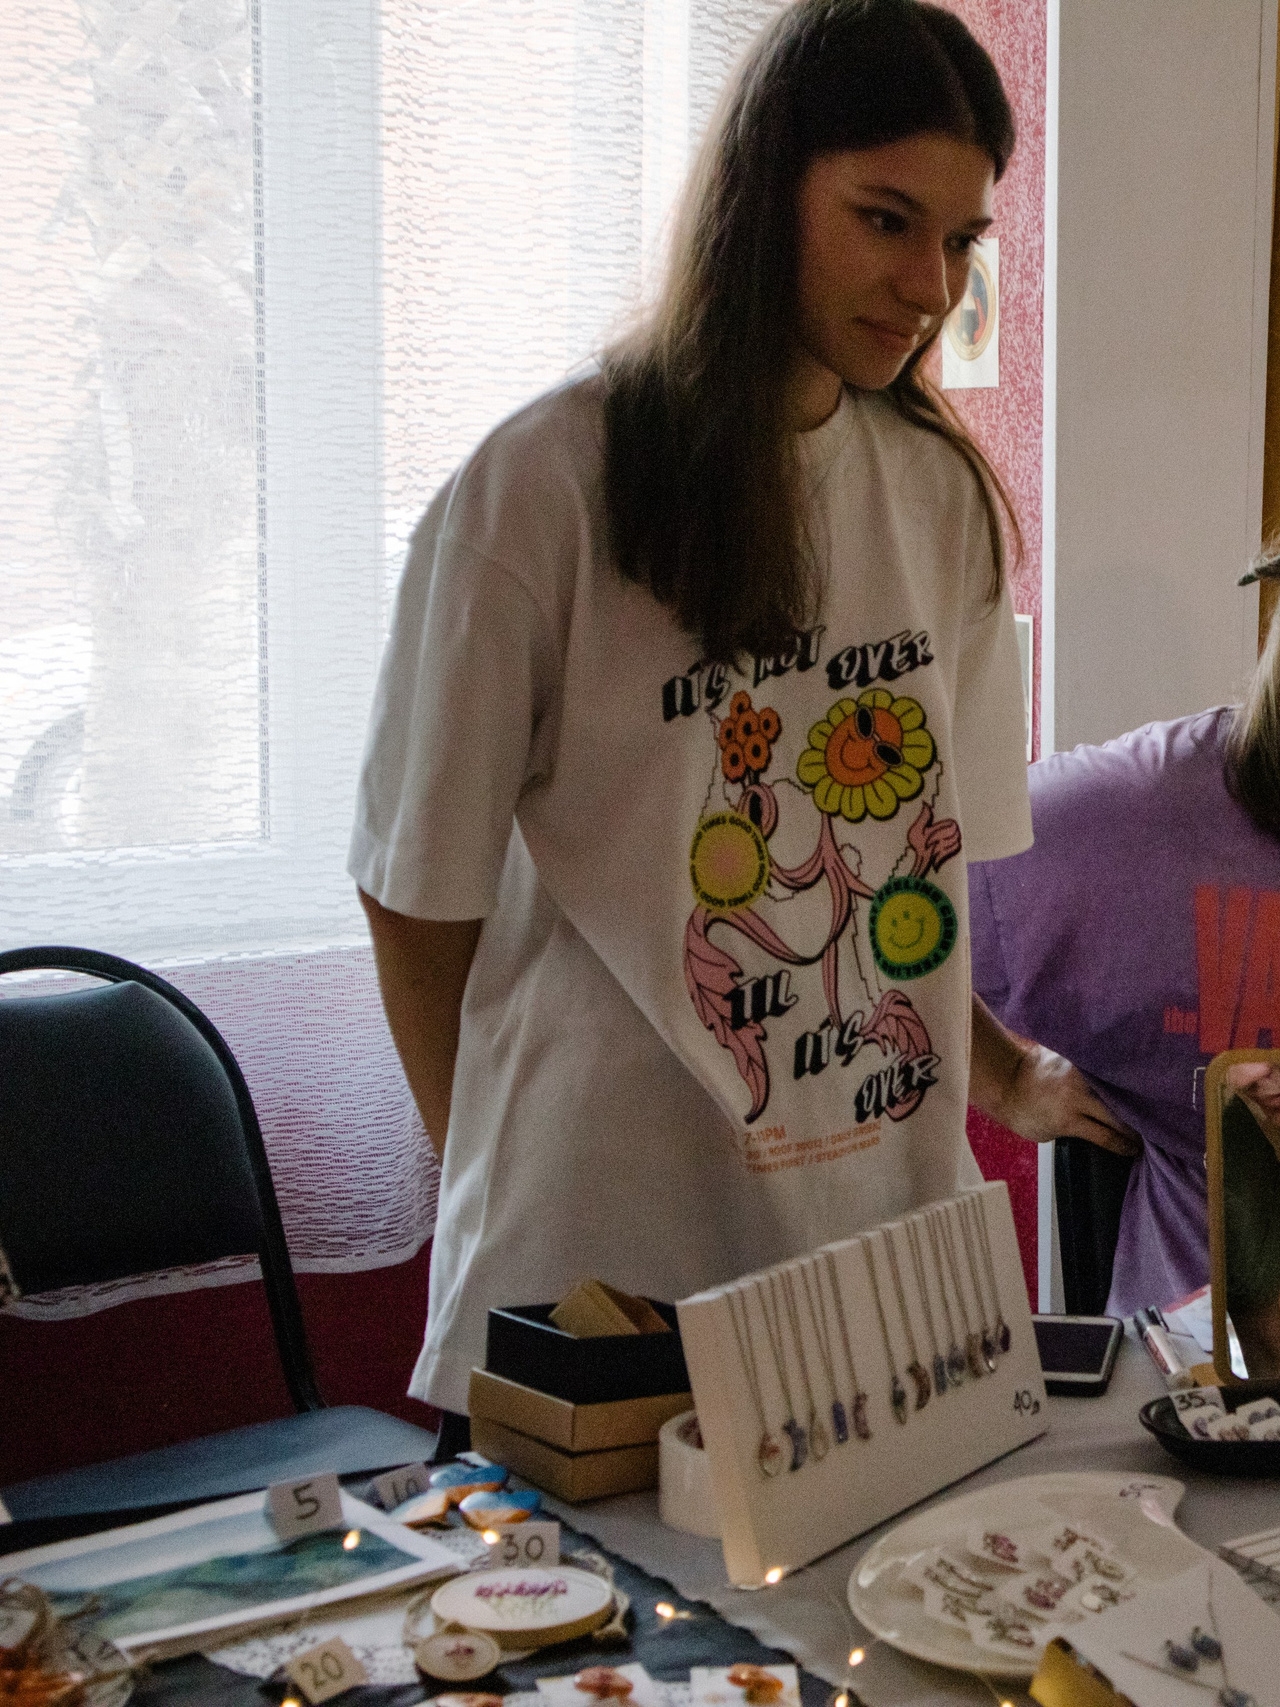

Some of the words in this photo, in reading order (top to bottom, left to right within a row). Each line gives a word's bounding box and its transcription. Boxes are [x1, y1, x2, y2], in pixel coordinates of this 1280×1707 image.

[826, 630, 934, 690] OVER
[723, 970, 799, 1030] TIL
[854, 1053, 941, 1123] OVER
[292, 1483, 320, 1520] 5
[391, 1477, 422, 1504] 10
[502, 1533, 545, 1561] 30
[302, 1650, 345, 1693] 20
